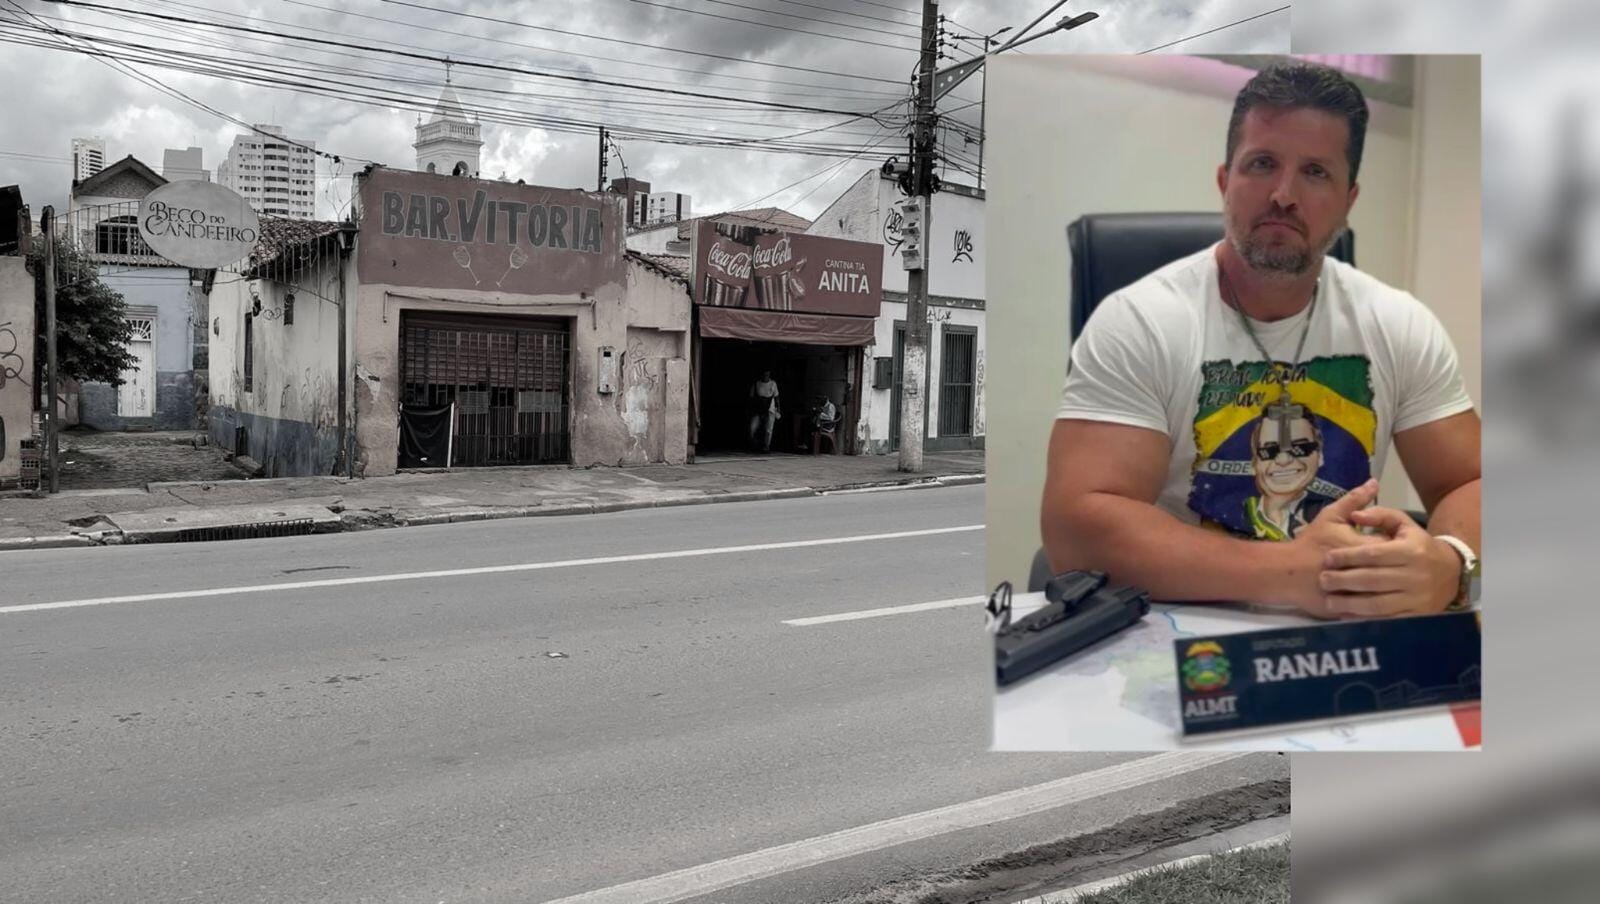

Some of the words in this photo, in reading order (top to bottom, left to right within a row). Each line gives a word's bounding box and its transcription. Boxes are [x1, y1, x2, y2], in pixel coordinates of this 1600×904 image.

[149, 201, 206, 223] BECO
[209, 215, 225, 224] DO
[825, 259, 854, 270] CANTINA
[855, 262, 865, 271] TIA
[818, 270, 870, 295] ANITA
[1208, 460, 1252, 473] ORDE
[1254, 647, 1380, 683] RANALLI
[1185, 696, 1237, 717] ALMT
